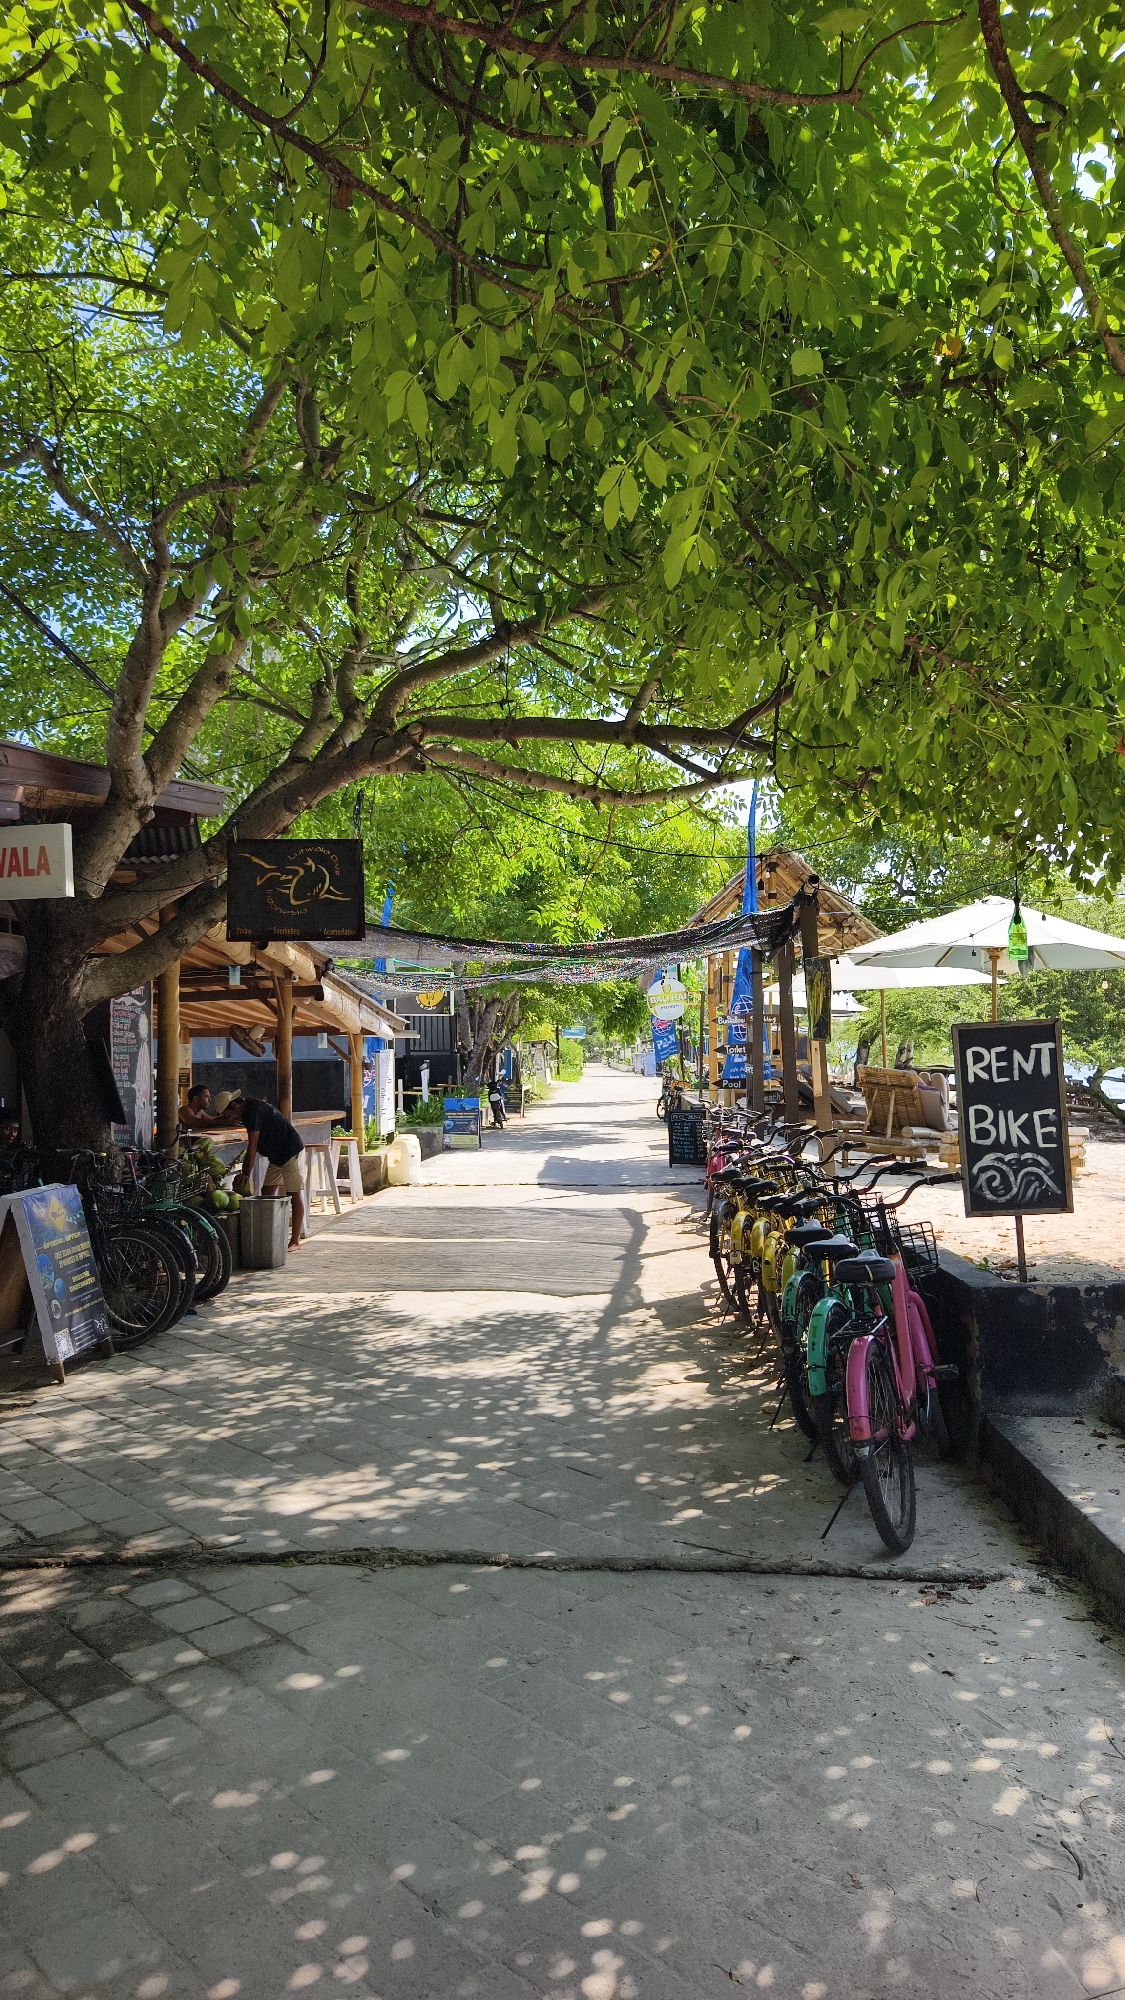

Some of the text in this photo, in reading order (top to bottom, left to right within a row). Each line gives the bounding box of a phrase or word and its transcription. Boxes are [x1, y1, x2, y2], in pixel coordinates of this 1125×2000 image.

[0, 846, 51, 878] ALA
[650, 992, 687, 1004] BALI HAI
[724, 1044, 746, 1054] Toilet
[966, 1041, 1056, 1085] RENT
[722, 1080, 741, 1088] Pool
[763, 1092, 781, 1102] each
[968, 1104, 1058, 1148] BIKE
